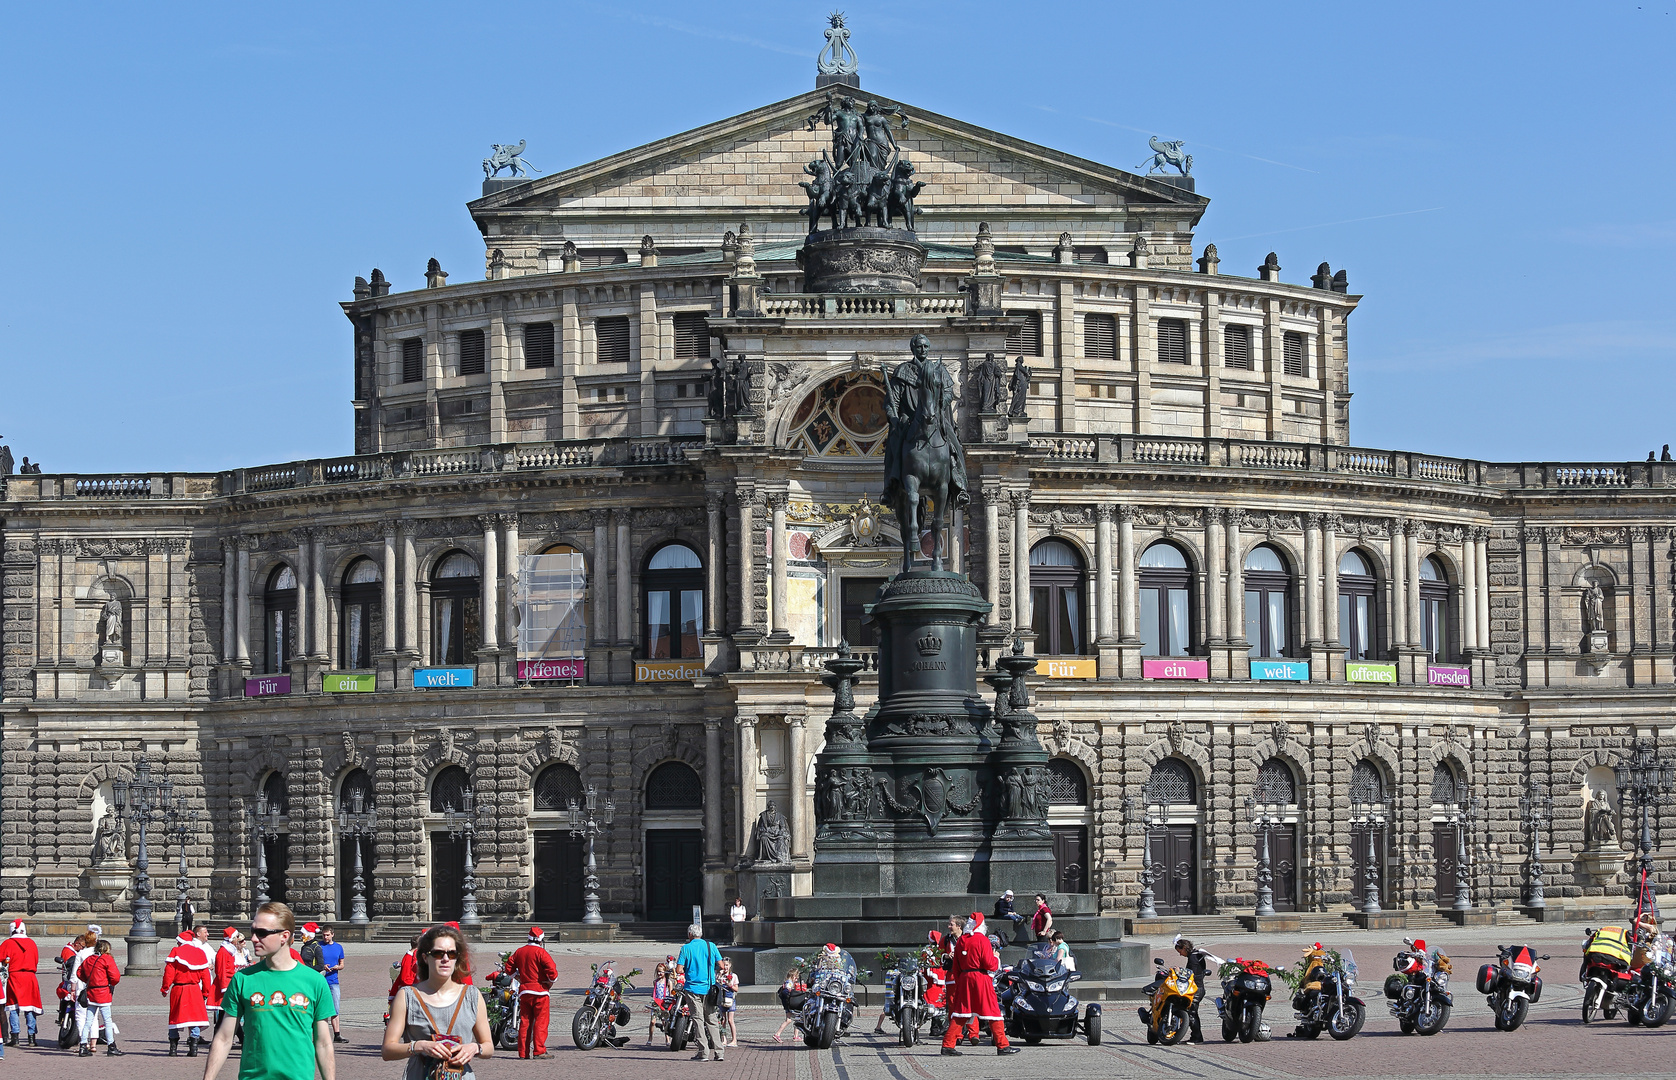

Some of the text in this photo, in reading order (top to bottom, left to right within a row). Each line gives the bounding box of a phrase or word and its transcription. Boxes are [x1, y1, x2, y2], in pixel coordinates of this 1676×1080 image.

[523, 662, 578, 678] offenes
[637, 665, 703, 680] Dresden
[912, 661, 947, 671] JOHANN
[1048, 662, 1077, 676] Für
[1164, 662, 1187, 677] ein
[1263, 665, 1297, 679] welt-
[426, 671, 460, 686] welt-
[1351, 667, 1393, 681] offenes
[1429, 669, 1470, 685] Dresden
[258, 680, 278, 694] Für
[339, 677, 358, 691] ein
